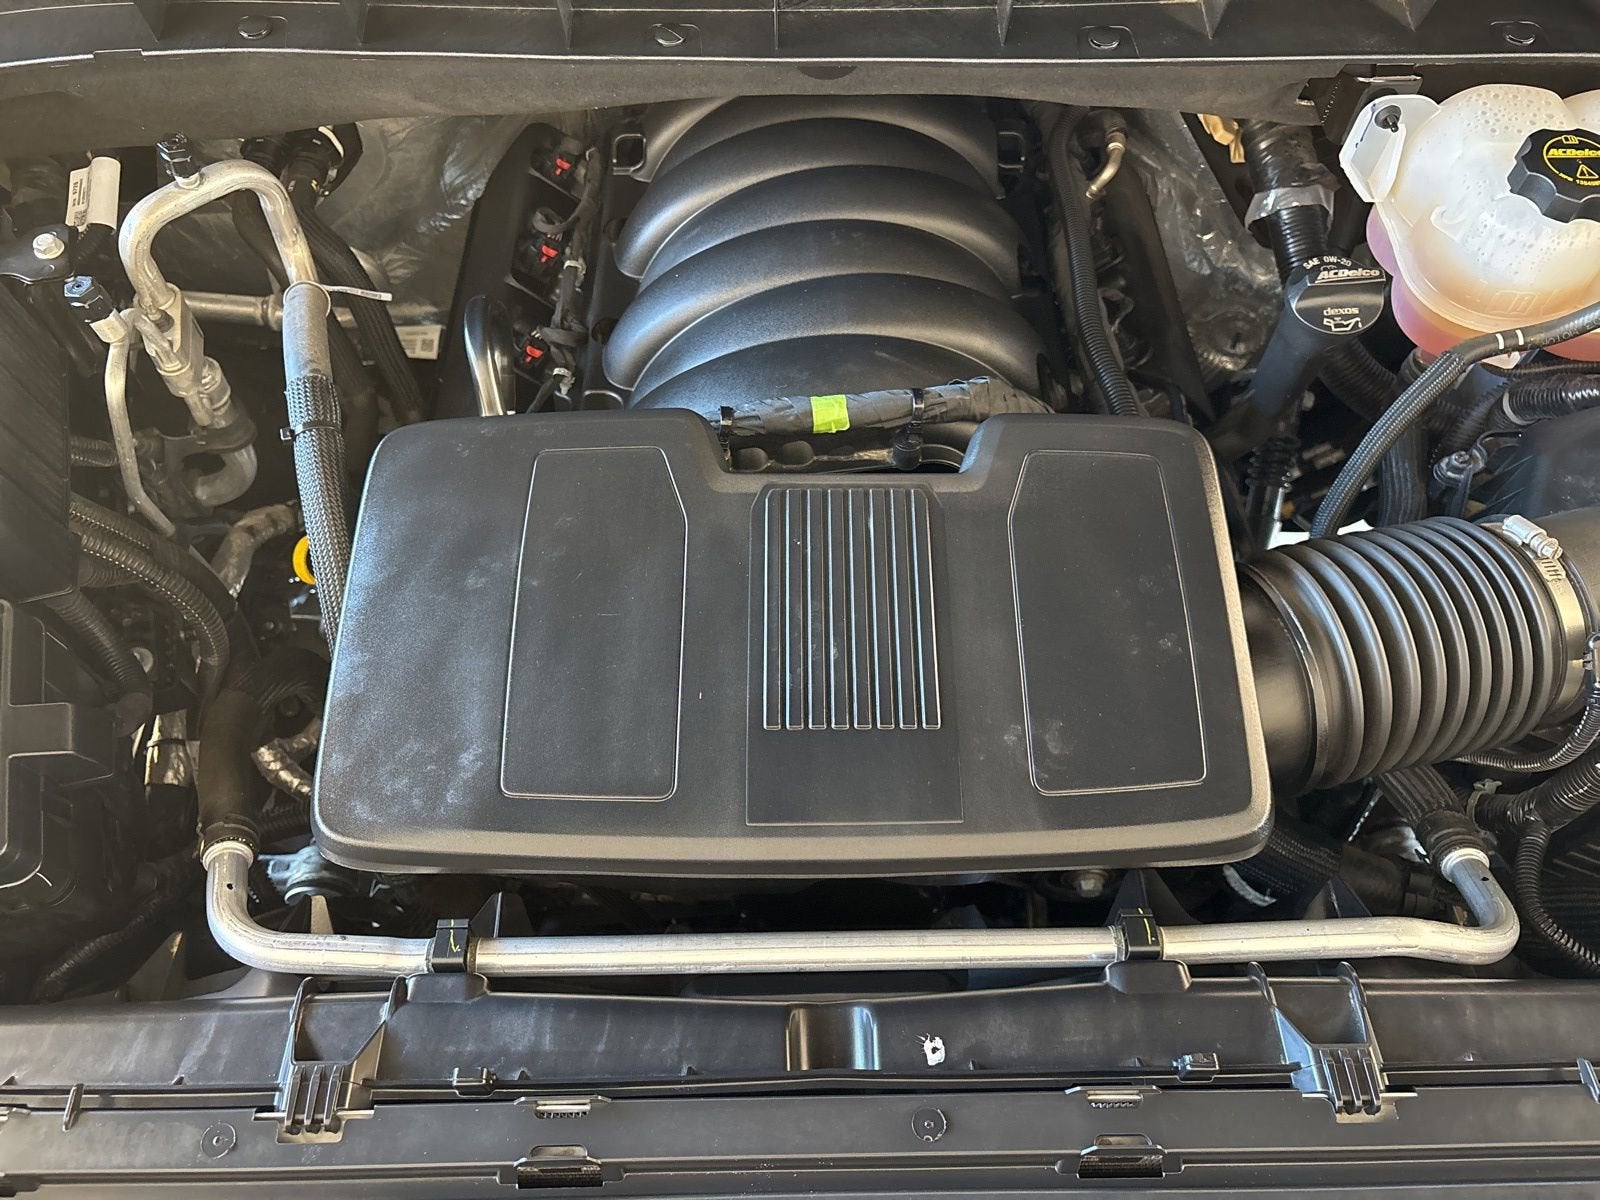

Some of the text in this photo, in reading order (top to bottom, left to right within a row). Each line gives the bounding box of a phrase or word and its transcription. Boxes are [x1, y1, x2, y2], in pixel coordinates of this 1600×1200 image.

[1303, 256, 1352, 270] SAE 0W-20
[1316, 268, 1380, 280] ACDelco
[1323, 307, 1360, 316] dexos
